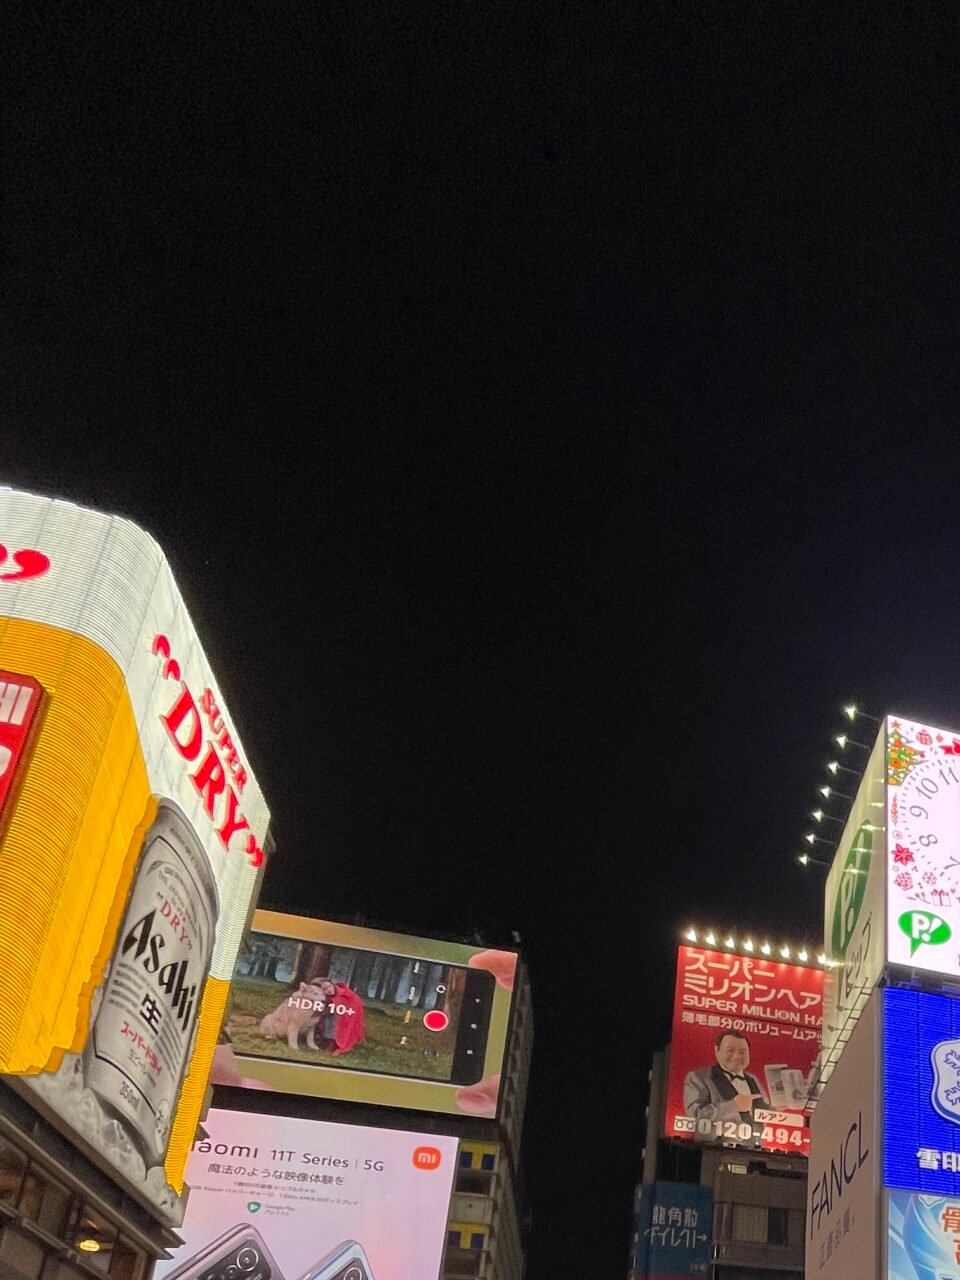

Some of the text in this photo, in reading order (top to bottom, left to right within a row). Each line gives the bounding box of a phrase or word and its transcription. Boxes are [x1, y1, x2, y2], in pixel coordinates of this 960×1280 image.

[201, 688, 247, 791] SUPER
[915, 777, 939, 801] 10
[938, 767, 959, 785] 11
[122, 908, 197, 1032] Asahi
[685, 952, 775, 980] スーパー
[287, 996, 355, 1017] HDR 10+
[684, 972, 823, 1010] ミリオンヘア
[139, 993, 162, 1036] 生
[683, 994, 737, 1014] SUPER
[742, 1003, 801, 1025] MILLION
[190, 1141, 384, 1172] iaomi 11T Series 5G
[207, 1163, 345, 1186] 魔法のような映像体験を
[811, 1110, 869, 1240] FANCL
